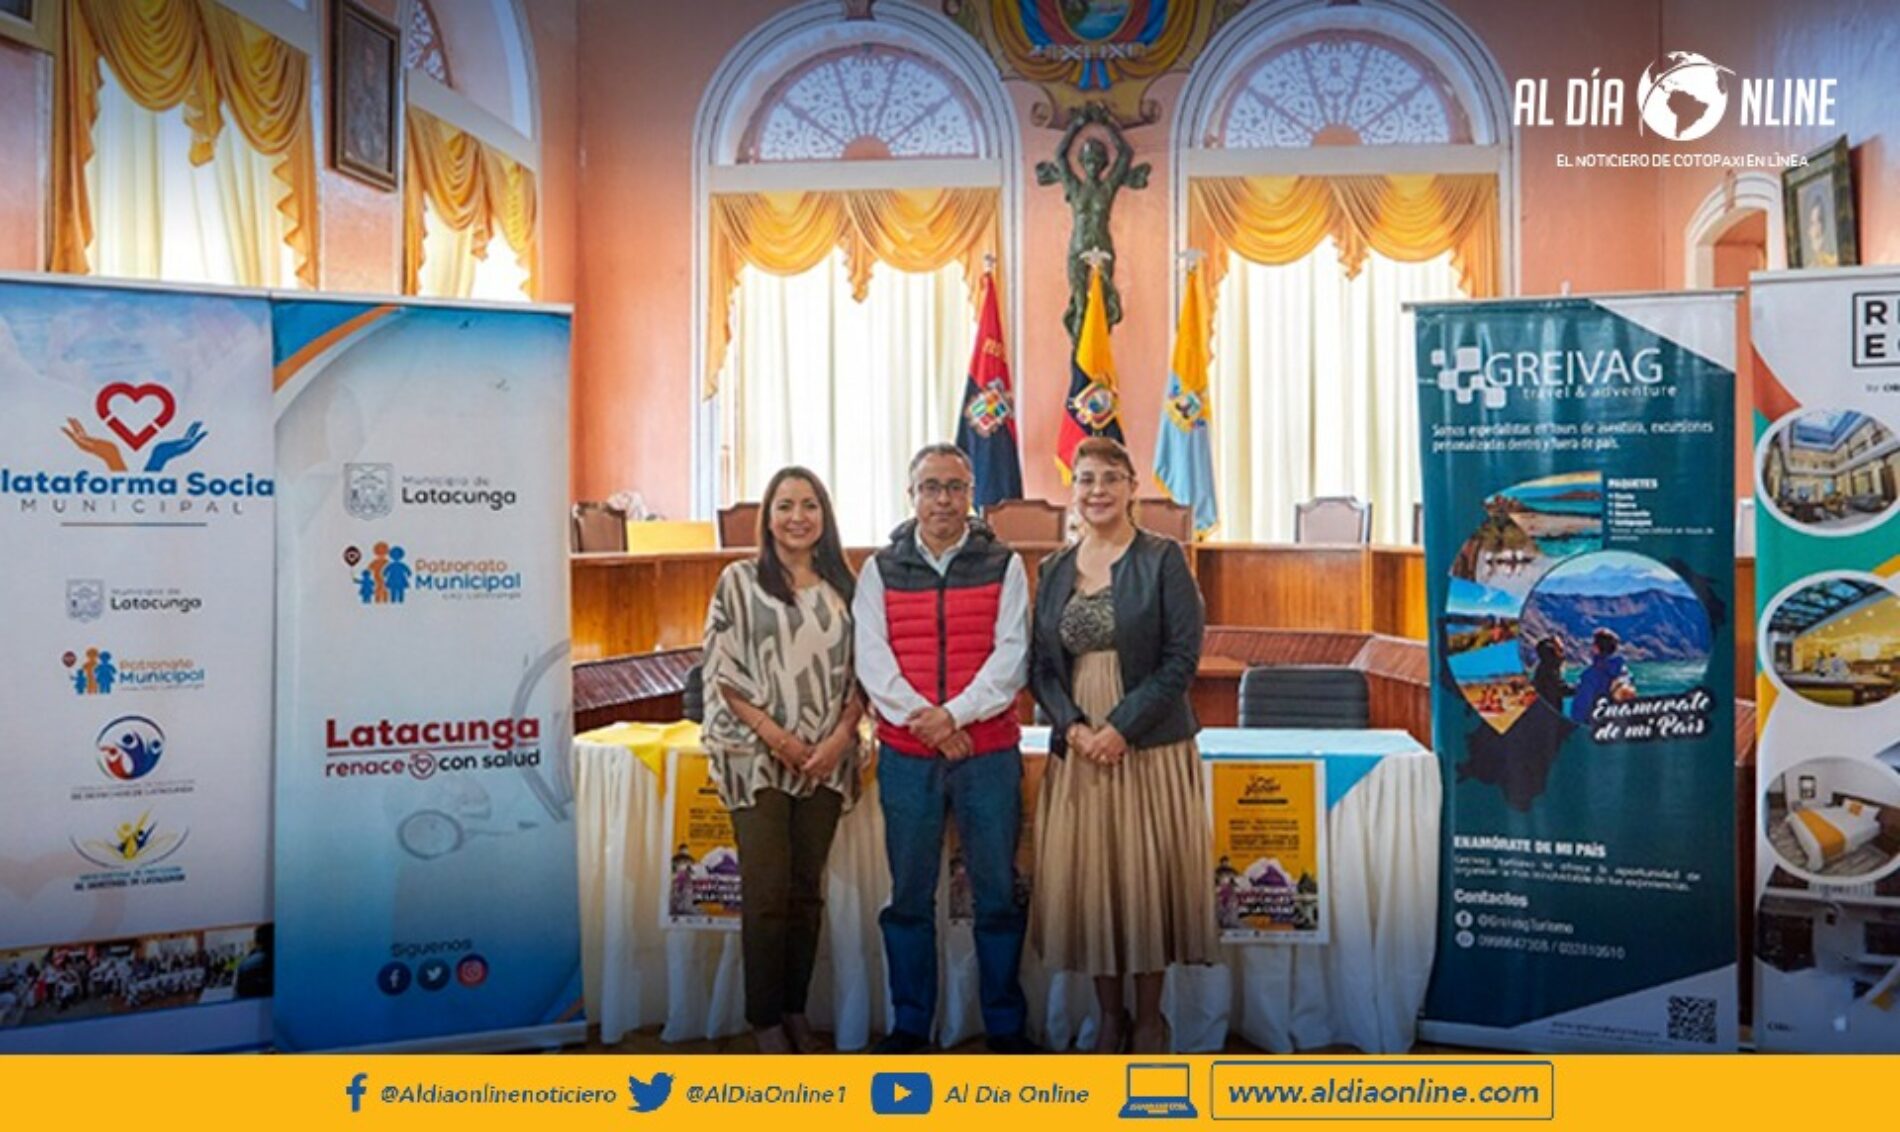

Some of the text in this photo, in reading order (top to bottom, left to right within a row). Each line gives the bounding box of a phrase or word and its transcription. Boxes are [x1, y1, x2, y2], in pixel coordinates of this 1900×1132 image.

[1485, 348, 1663, 388] GREIVAG
[1523, 384, 1678, 399] travel & adventure
[1581, 421, 1595, 434] de
[0, 469, 275, 497] lataforma Socia
[20, 499, 244, 515] MUNICIPAL
[402, 486, 517, 511] Latacunga
[415, 558, 508, 573] Patronato
[415, 573, 521, 592] Municipal
[110, 596, 202, 613] Latacunga
[119, 669, 205, 685] Municipal
[326, 718, 540, 751] Latacunga
[1595, 722, 1621, 741] de
[1625, 718, 1652, 738] mi
[325, 748, 541, 777] renace con salud
[1453, 835, 1531, 853] ENAMÓRATE
[1535, 840, 1552, 855] DE
[1555, 842, 1573, 856] MI
[1453, 888, 1529, 908] Contactos
